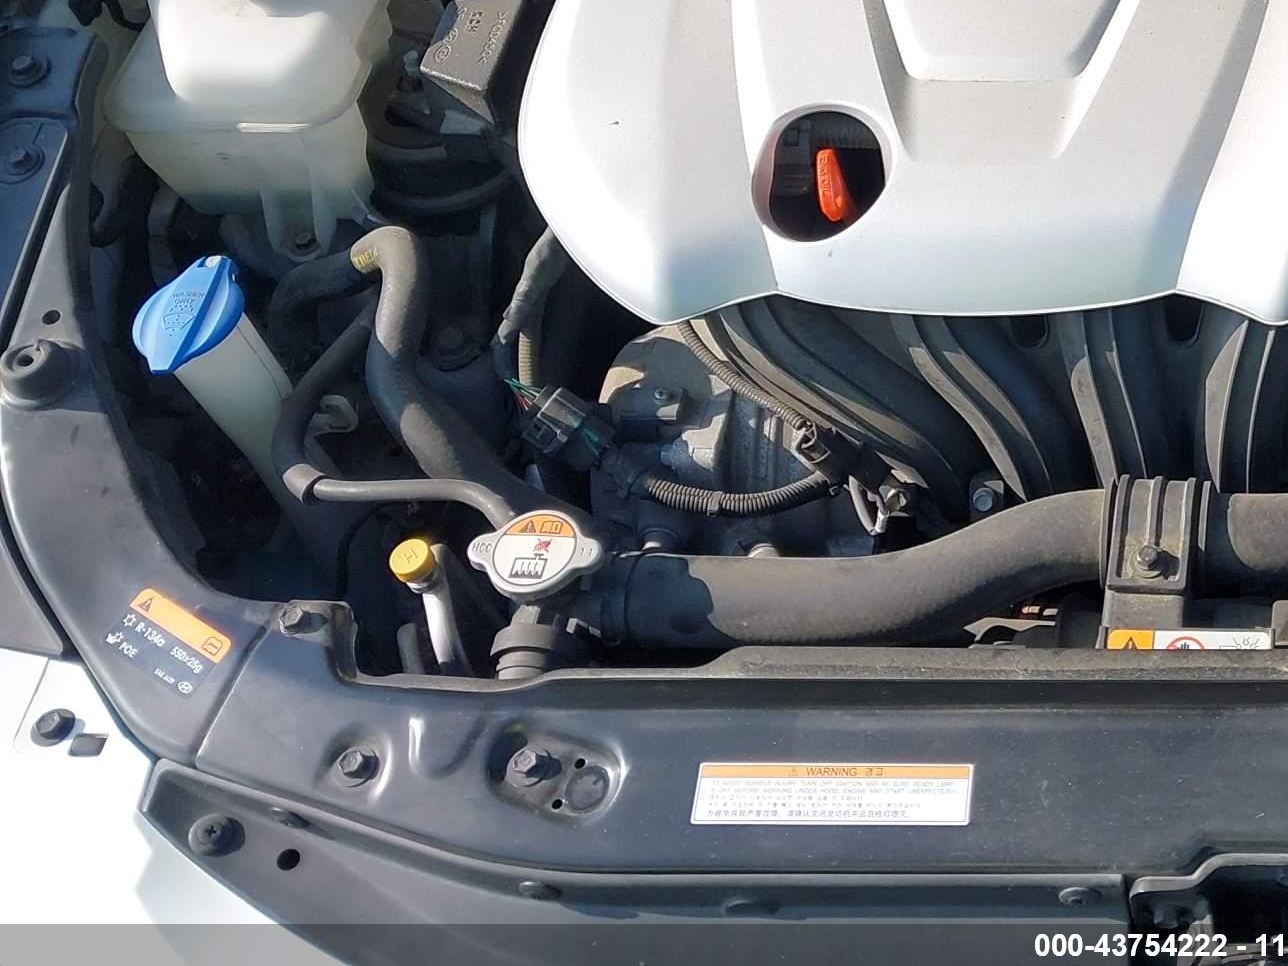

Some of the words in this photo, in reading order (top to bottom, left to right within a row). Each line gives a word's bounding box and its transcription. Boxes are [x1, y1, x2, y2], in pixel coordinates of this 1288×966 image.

[135, 622, 166, 647] R-134a
[119, 641, 138, 658] POE
[806, 767, 857, 776] WARNING
